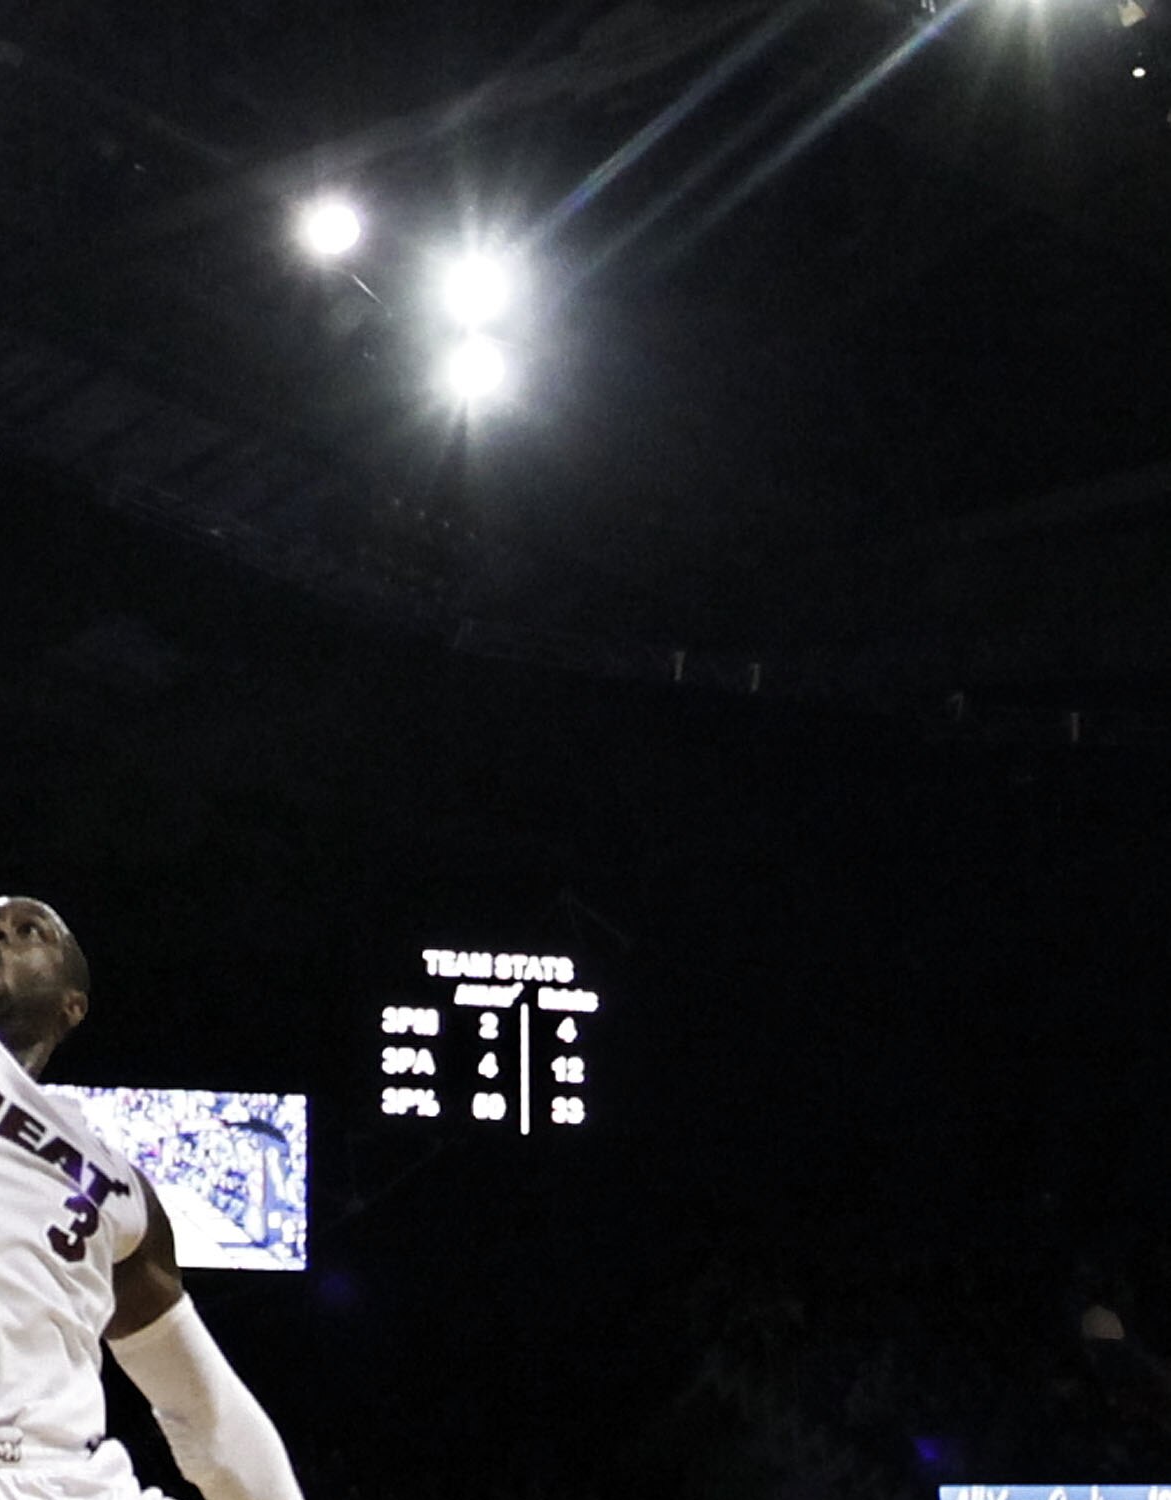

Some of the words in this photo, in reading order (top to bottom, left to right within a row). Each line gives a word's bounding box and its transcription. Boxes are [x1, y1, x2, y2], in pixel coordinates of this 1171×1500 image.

[422, 949, 493, 978] TEAM
[494, 953, 574, 984] STATS
[479, 1012, 499, 1039] 2
[556, 1017, 578, 1043] 4
[382, 1047, 436, 1075] 3PA
[478, 1052, 500, 1079] 4
[551, 1056, 585, 1083] 12
[46, 1193, 100, 1263] 3
